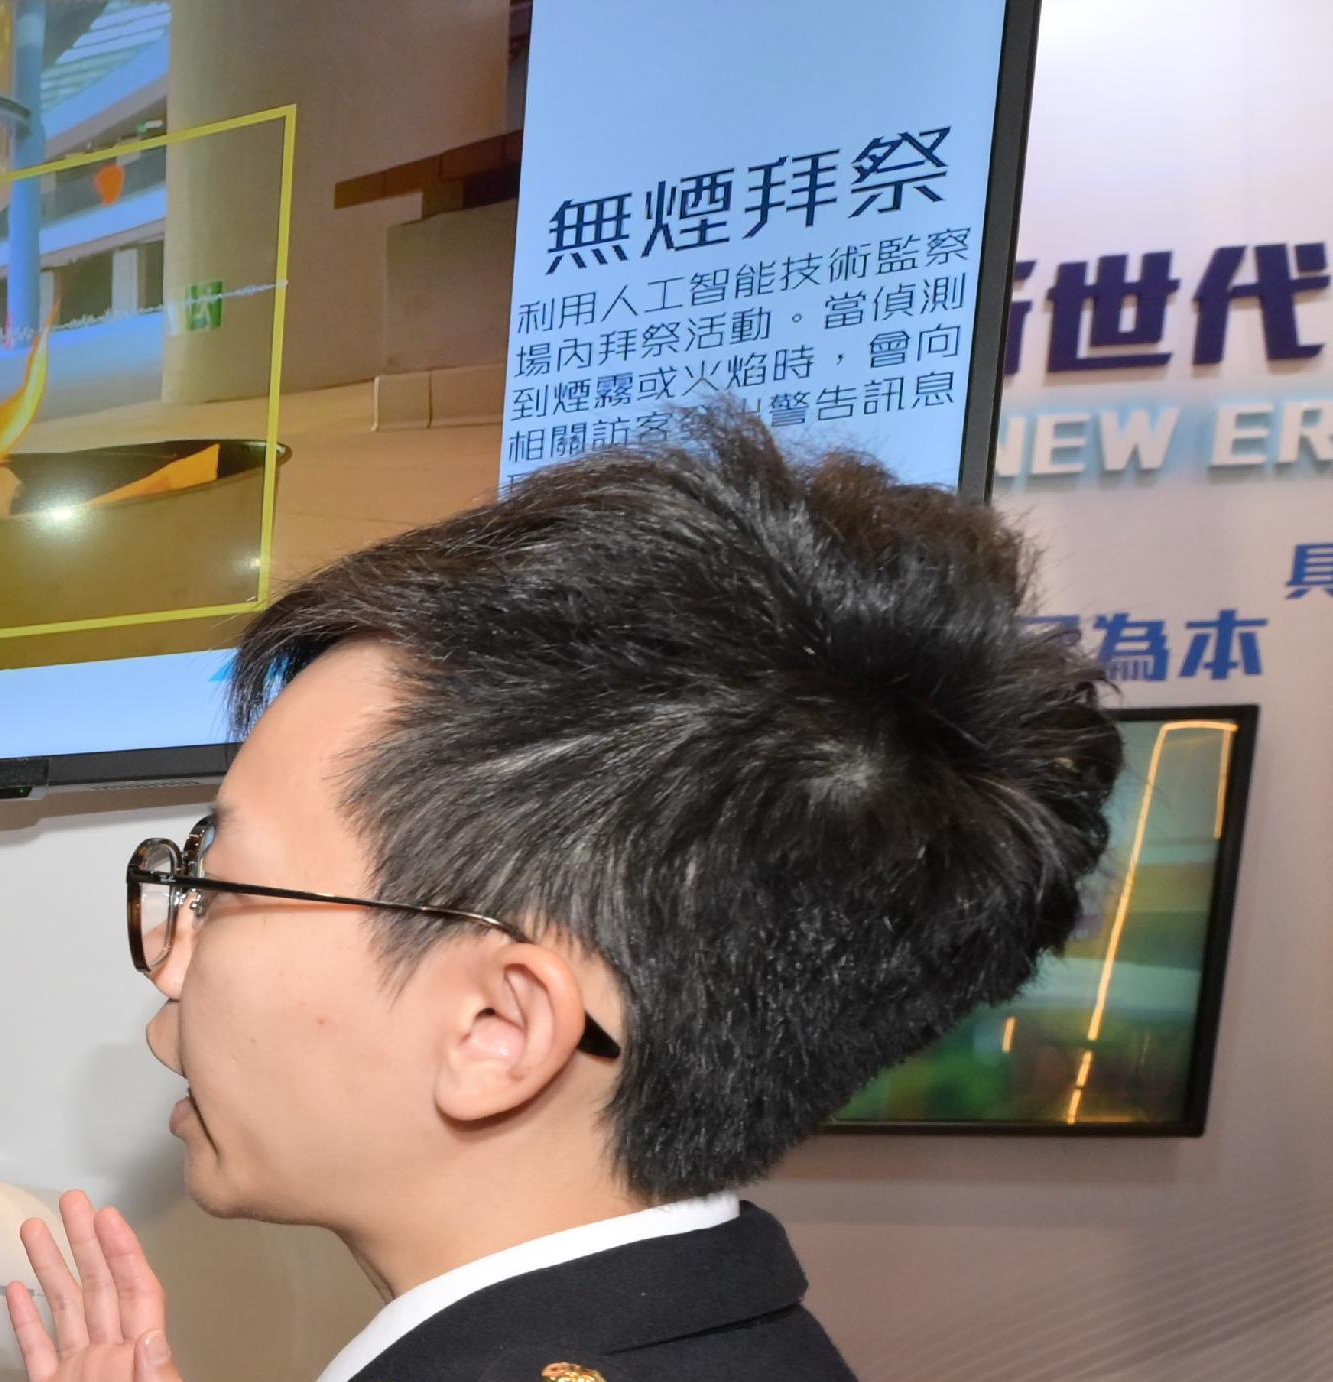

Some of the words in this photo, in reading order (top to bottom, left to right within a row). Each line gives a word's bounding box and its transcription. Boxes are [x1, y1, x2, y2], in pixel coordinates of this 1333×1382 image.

[546, 125, 952, 275] 無煙拜祭
[515, 272, 967, 378] 場內拜祭活動。當偵測
[517, 226, 972, 334] 利用人工智能技術監察
[512, 323, 961, 422] 到煙霧或火焰時，會向
